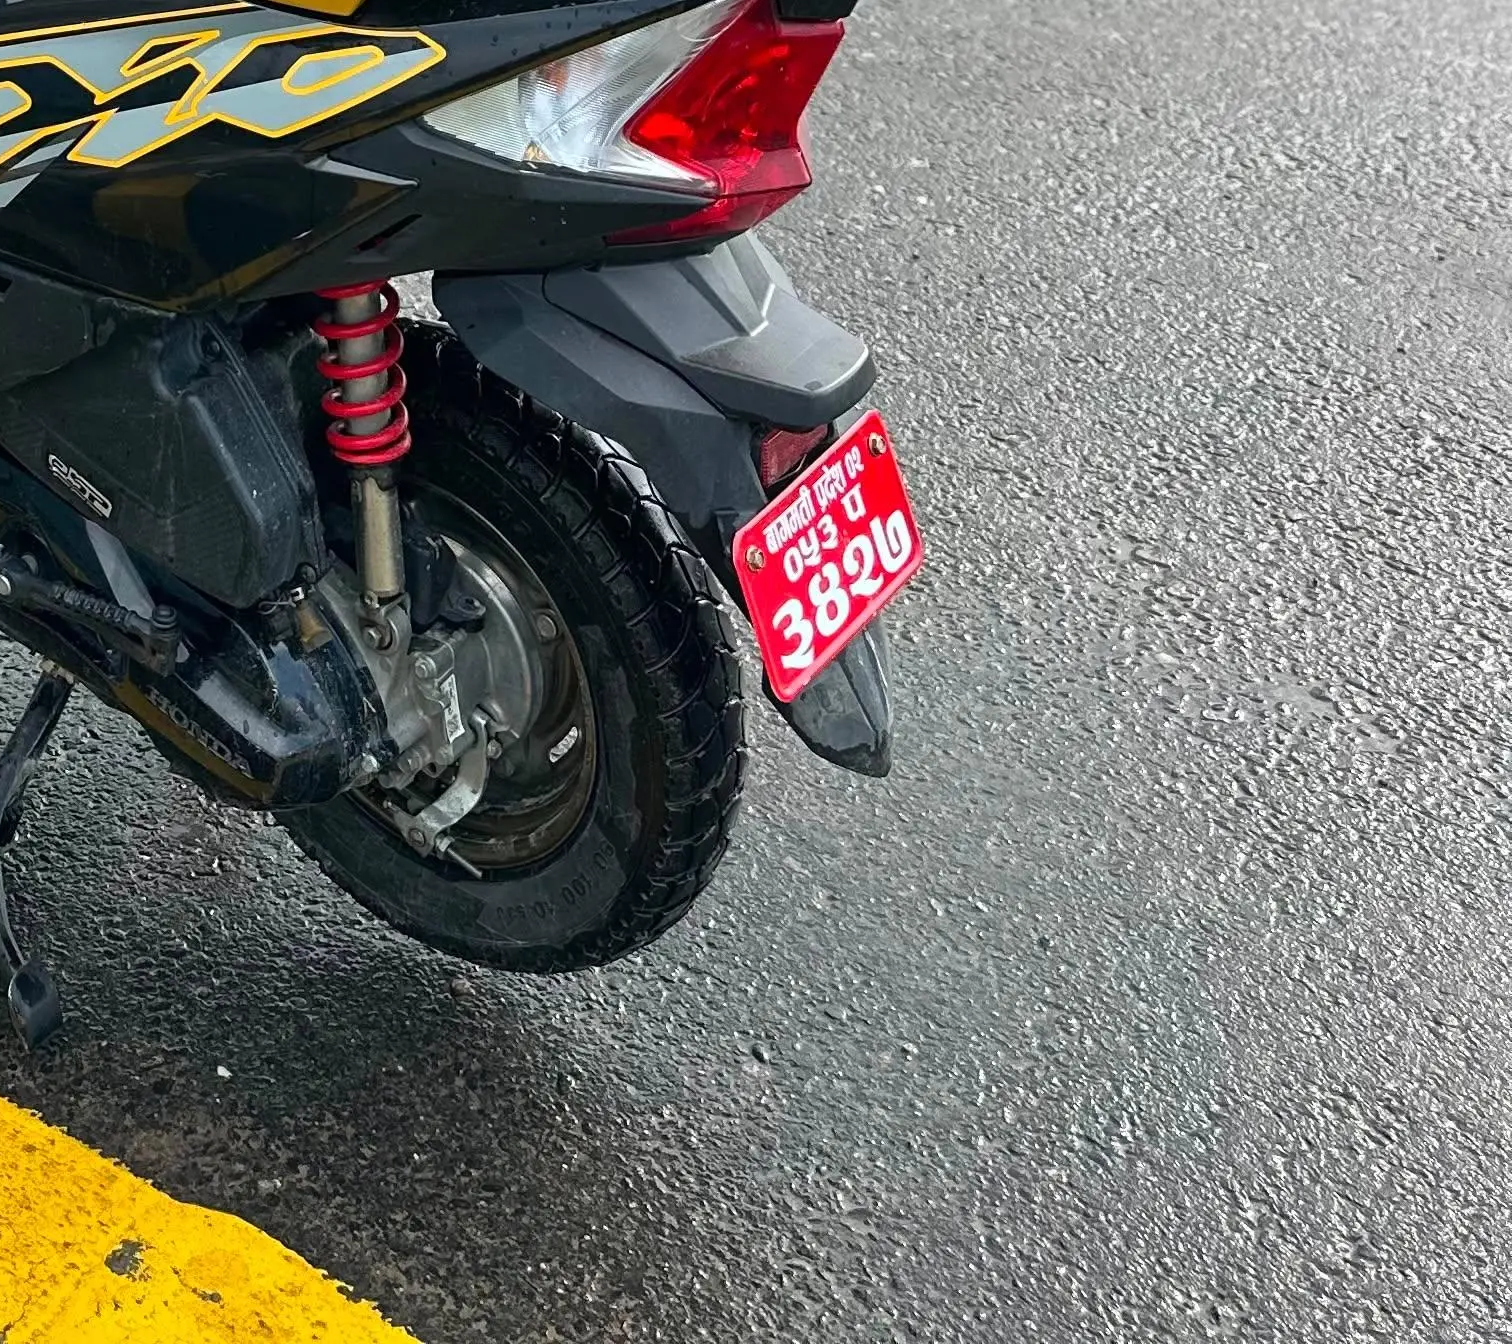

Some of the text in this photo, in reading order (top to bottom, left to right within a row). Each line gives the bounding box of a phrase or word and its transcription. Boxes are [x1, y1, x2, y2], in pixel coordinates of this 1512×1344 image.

[844, 445, 864, 480] ०२
[783, 483, 867, 583] ०५३ प
[772, 509, 913, 670] ३४२७
[145, 684, 254, 780] HONDA
